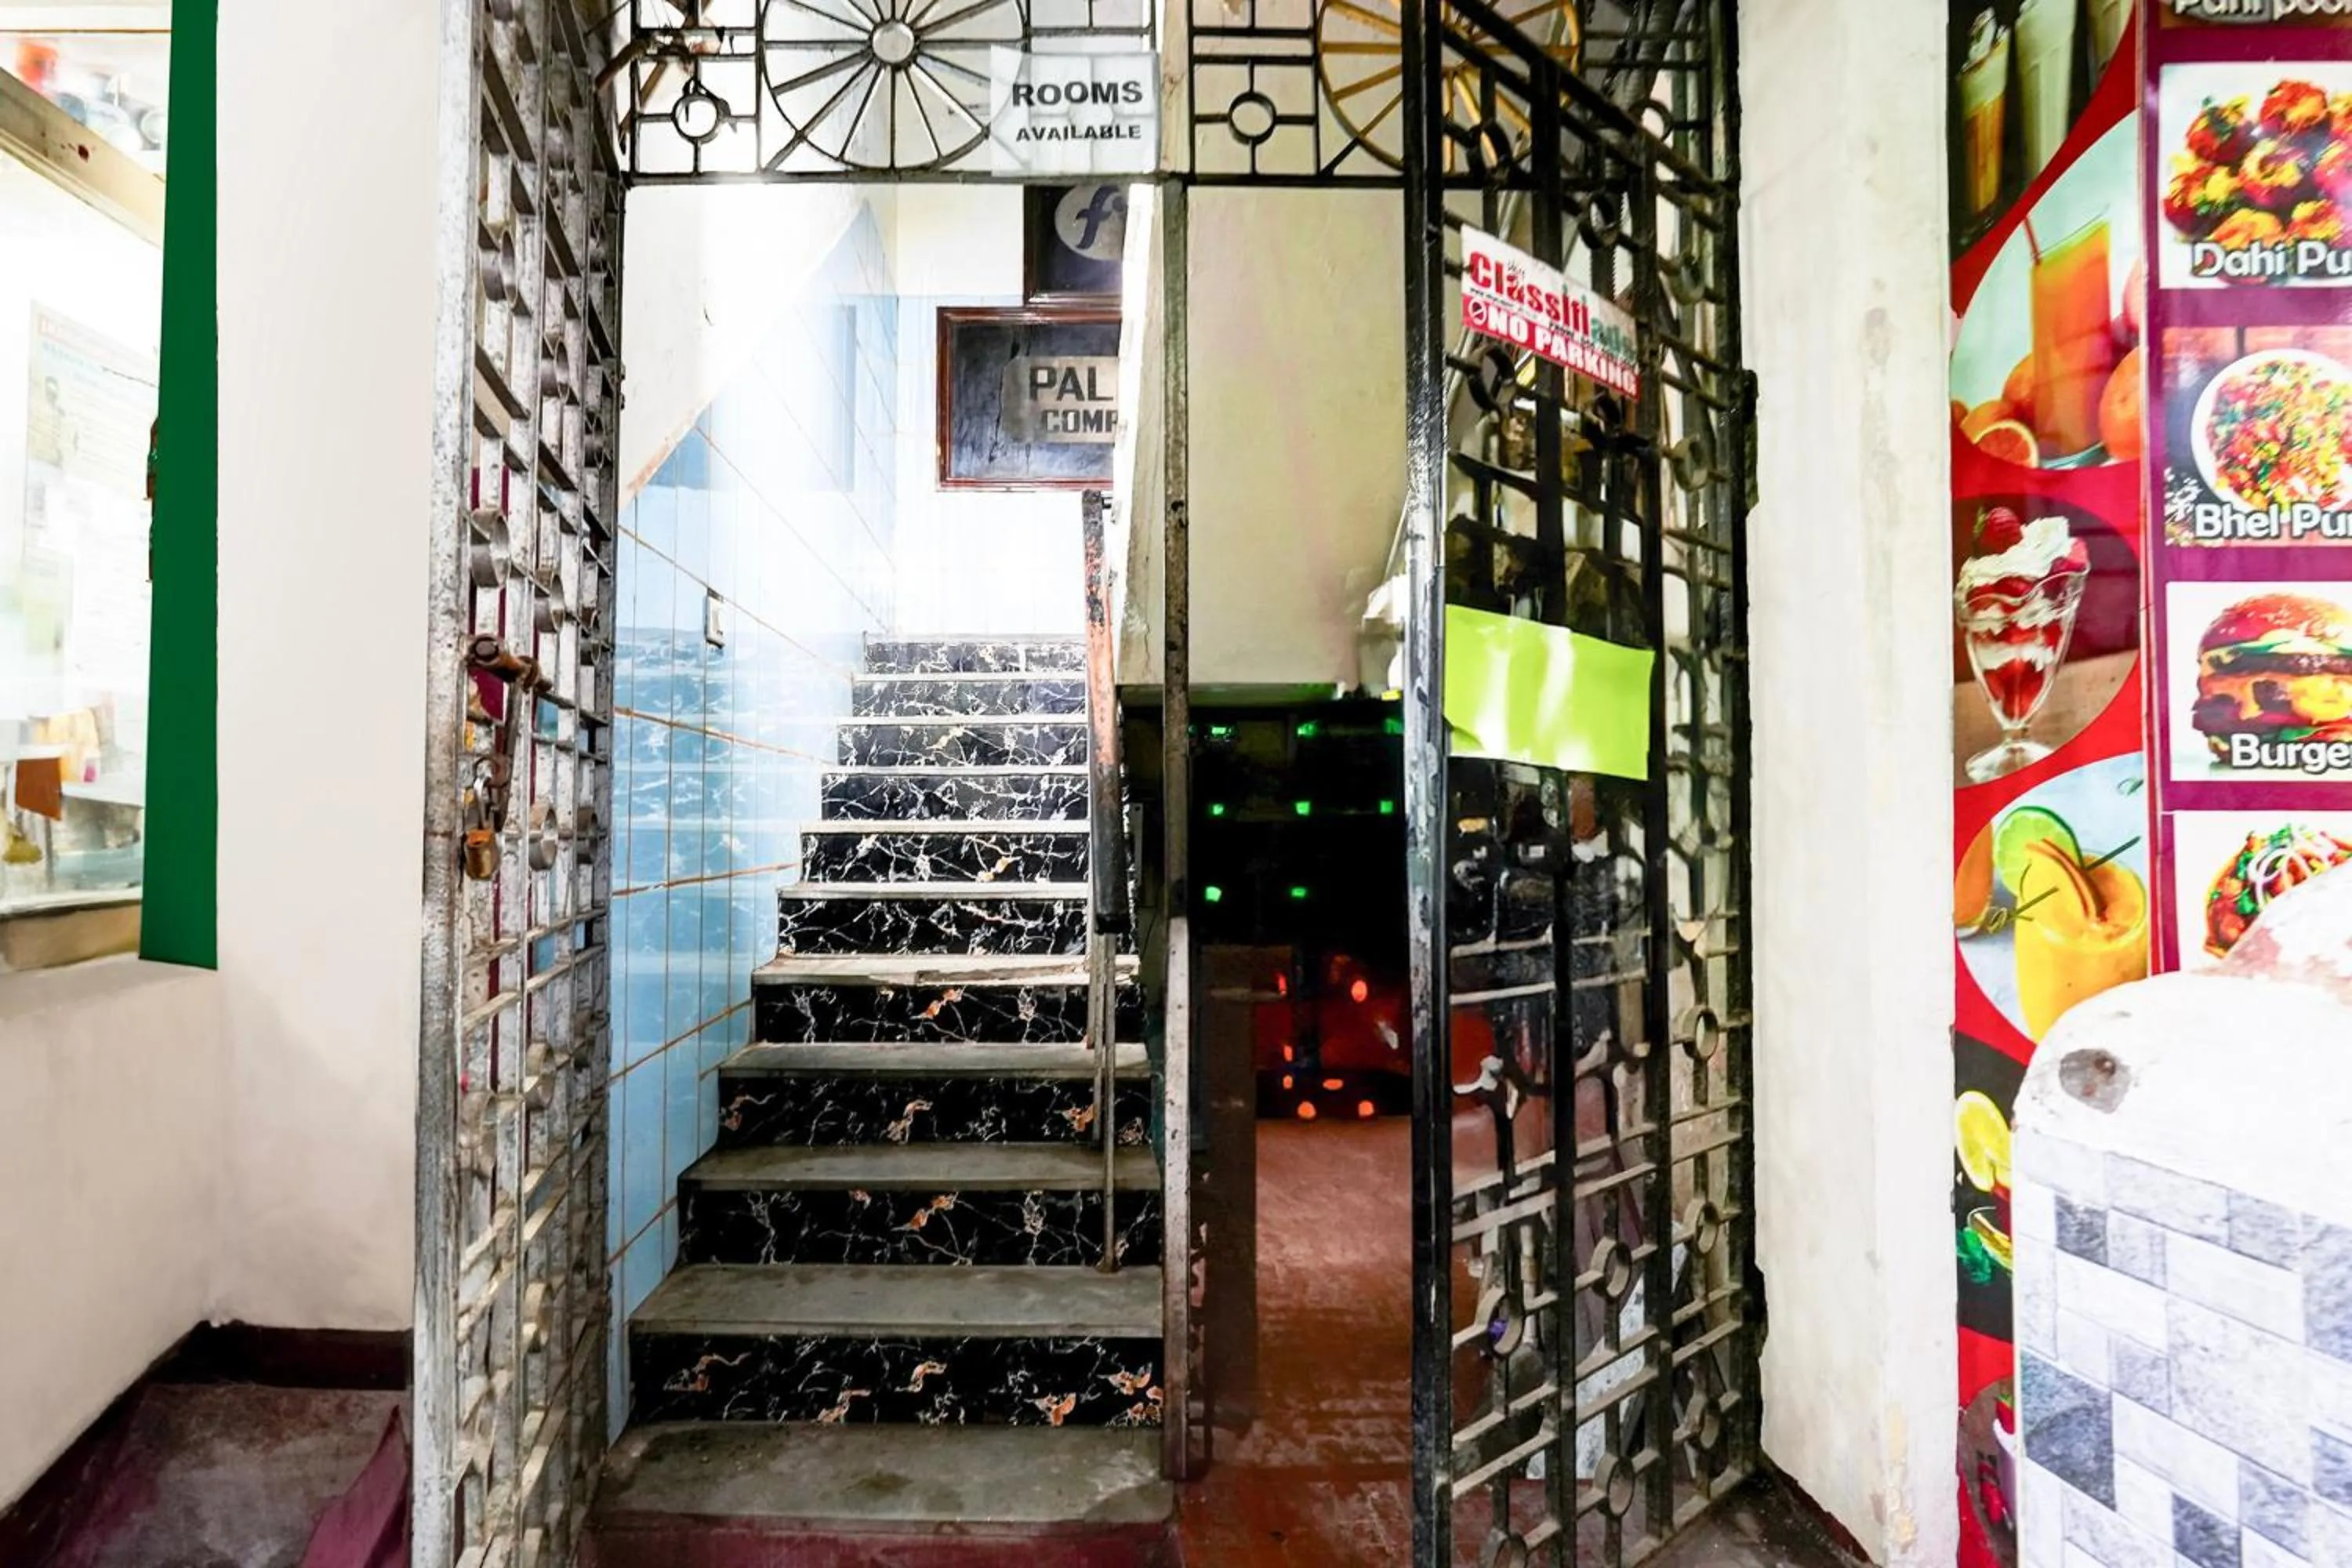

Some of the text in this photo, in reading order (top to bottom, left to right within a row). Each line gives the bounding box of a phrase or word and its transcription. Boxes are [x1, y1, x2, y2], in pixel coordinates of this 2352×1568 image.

[1012, 81, 1143, 107] ROOMS
[1016, 124, 1142, 142] AVAILABLE
[2193, 241, 2287, 276] Dahi
[1487, 303, 1529, 344] NO
[1534, 322, 1636, 397] PARKING
[1029, 366, 1114, 401] PAL
[2195, 503, 2280, 537] Bhel
[2231, 733, 2352, 773] Burge
